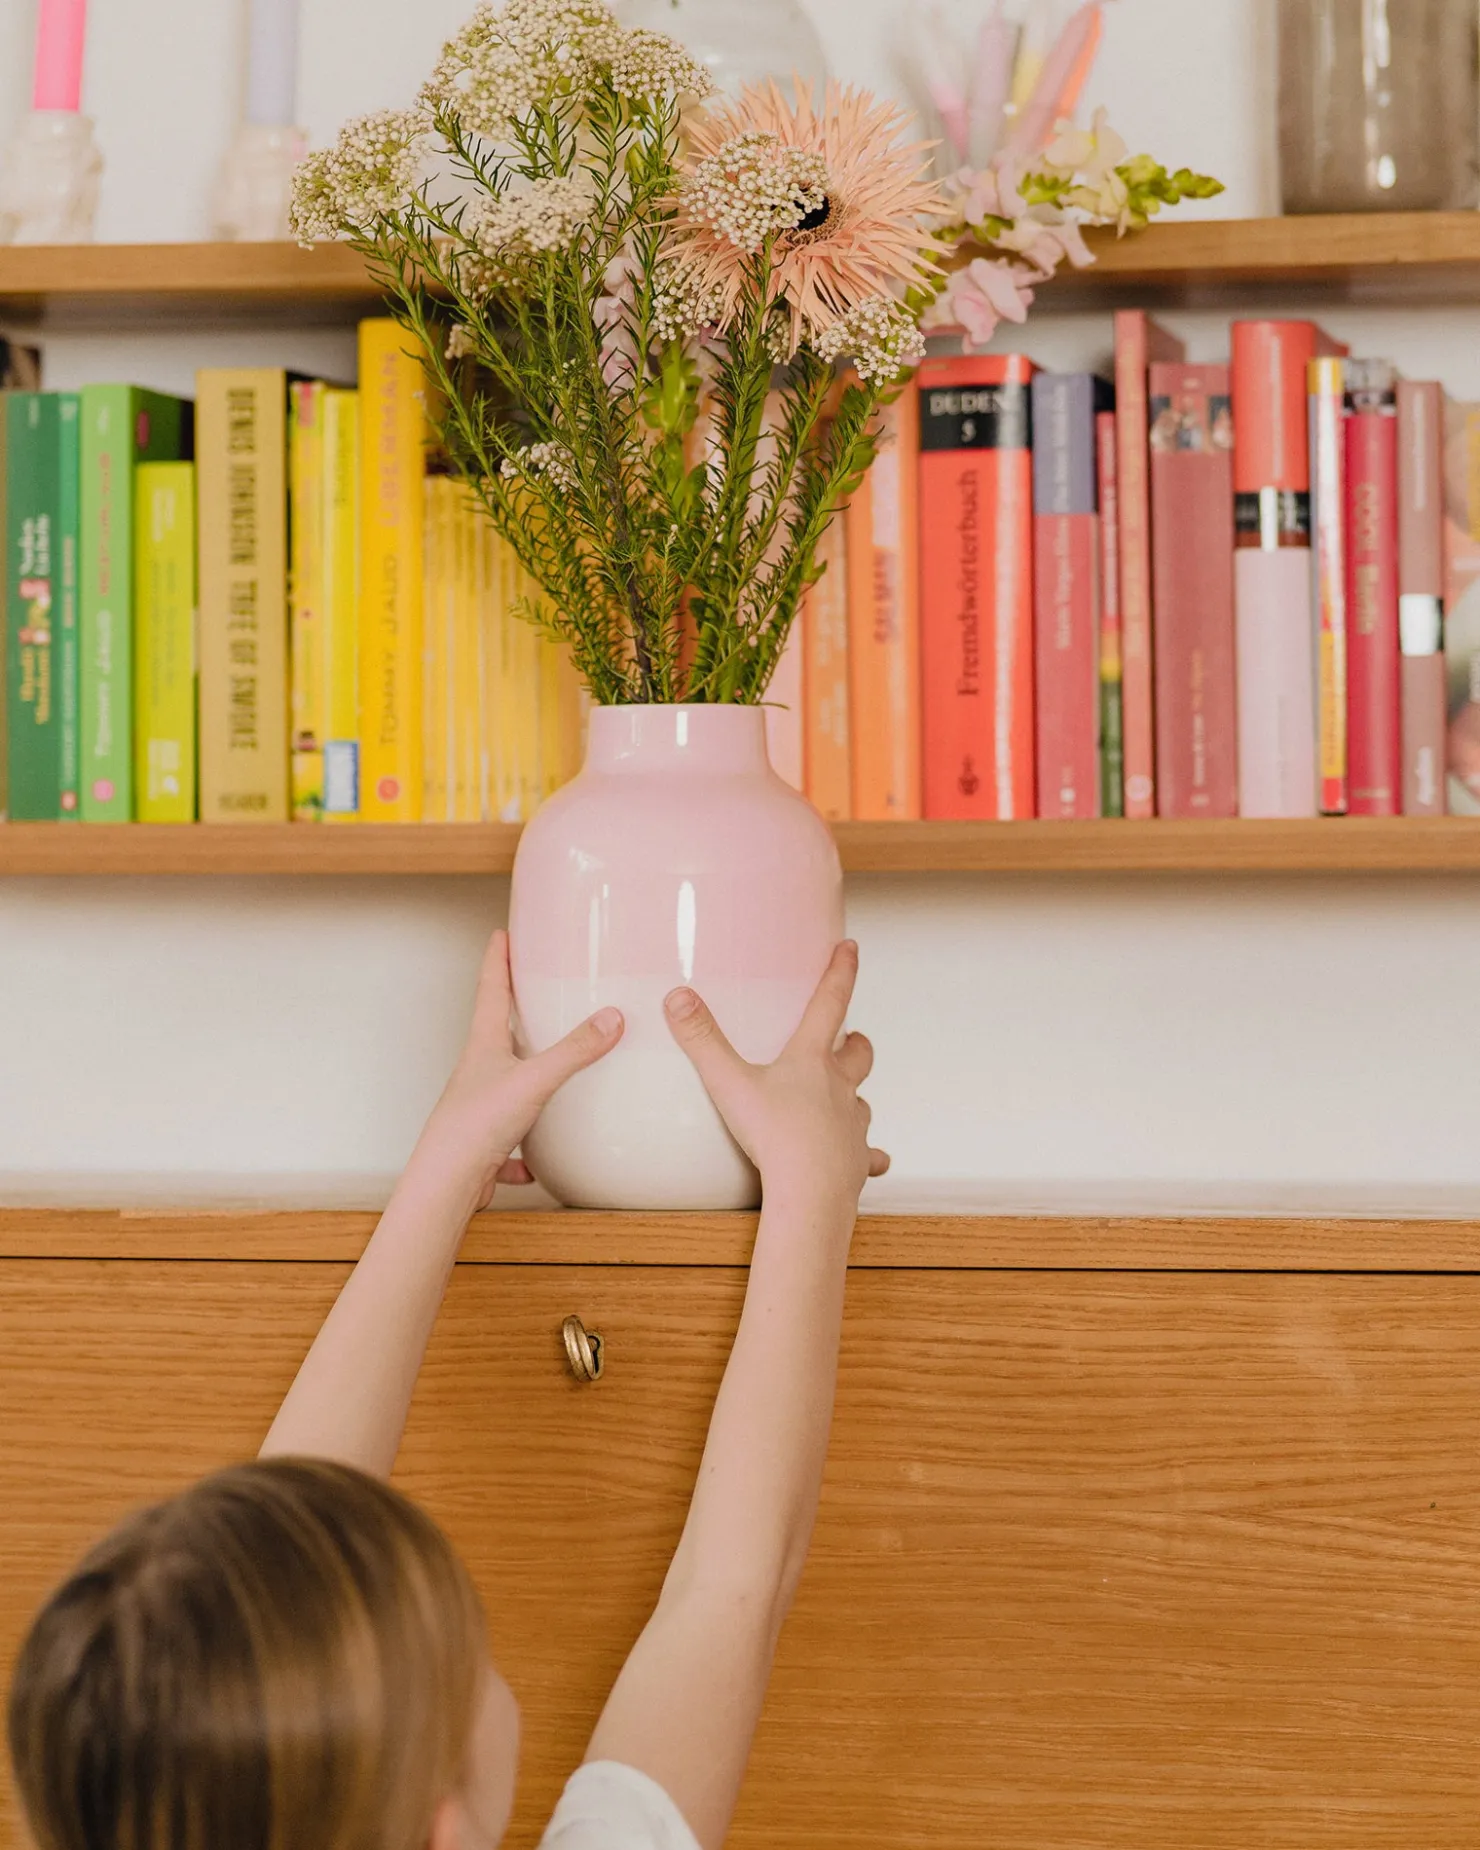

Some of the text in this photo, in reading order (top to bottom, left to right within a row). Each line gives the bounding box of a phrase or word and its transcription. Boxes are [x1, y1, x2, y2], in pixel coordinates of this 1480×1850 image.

[929, 390, 1011, 416] DUDEN
[227, 387, 258, 751] DENIS JOHNSON TREE OF SMOKE
[380, 553, 398, 635] JAUD
[955, 470, 980, 698] Fremdwörterbuch
[380, 651, 398, 748] TOMMY
